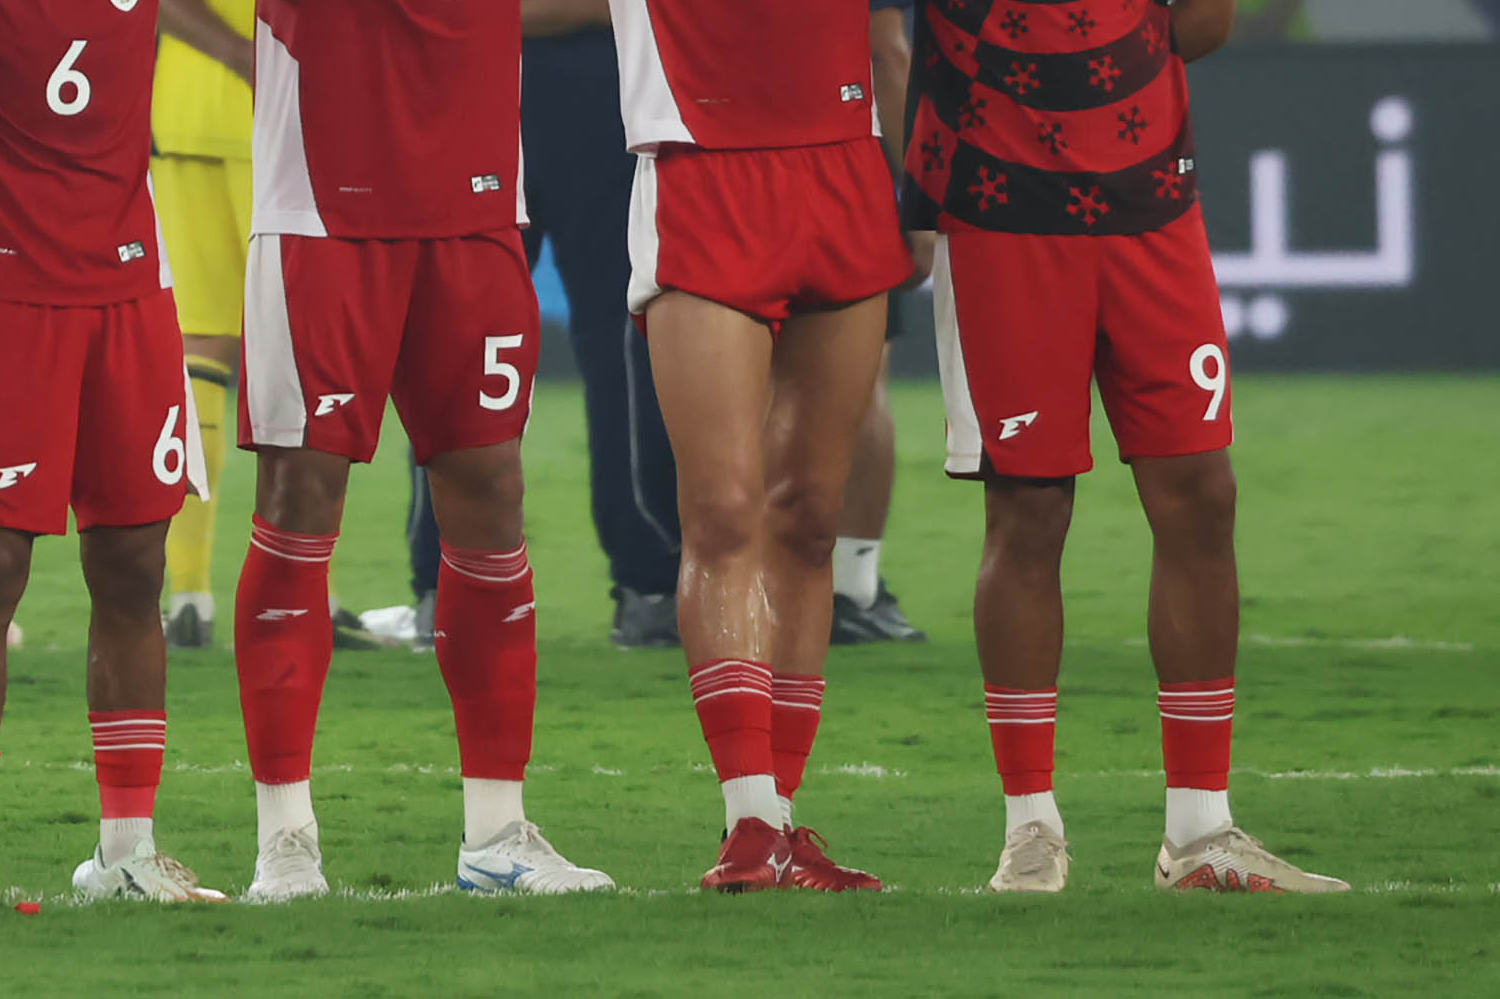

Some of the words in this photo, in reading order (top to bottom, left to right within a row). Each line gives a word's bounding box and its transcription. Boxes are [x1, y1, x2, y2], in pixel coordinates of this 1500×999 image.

[46, 40, 91, 115] 6
[479, 333, 523, 410] 5
[1189, 343, 1226, 421] 9
[152, 405, 186, 485] 6
